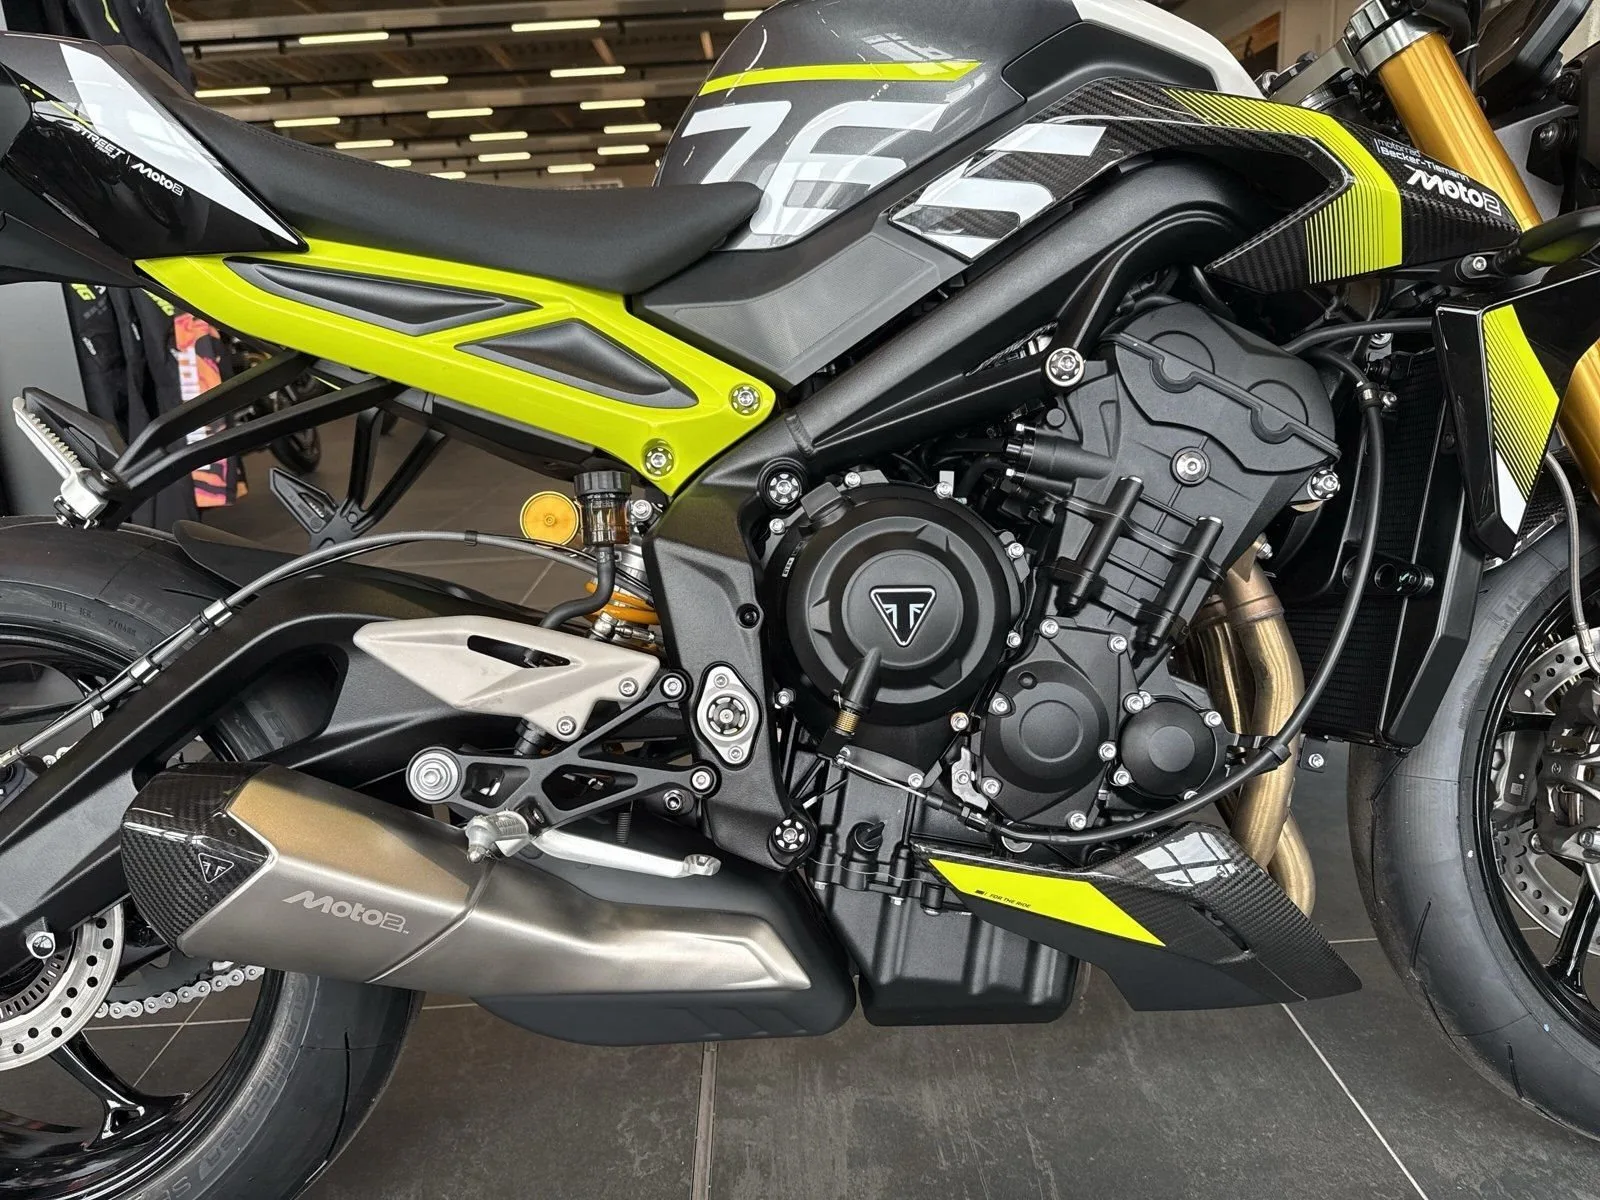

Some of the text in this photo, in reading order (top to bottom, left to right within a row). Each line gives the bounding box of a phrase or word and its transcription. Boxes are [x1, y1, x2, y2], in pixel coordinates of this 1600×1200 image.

[71, 122, 184, 197] STREET Moto2
[1380, 146, 1470, 182] Becker-Tiemann
[1404, 163, 1502, 217] Moto2
